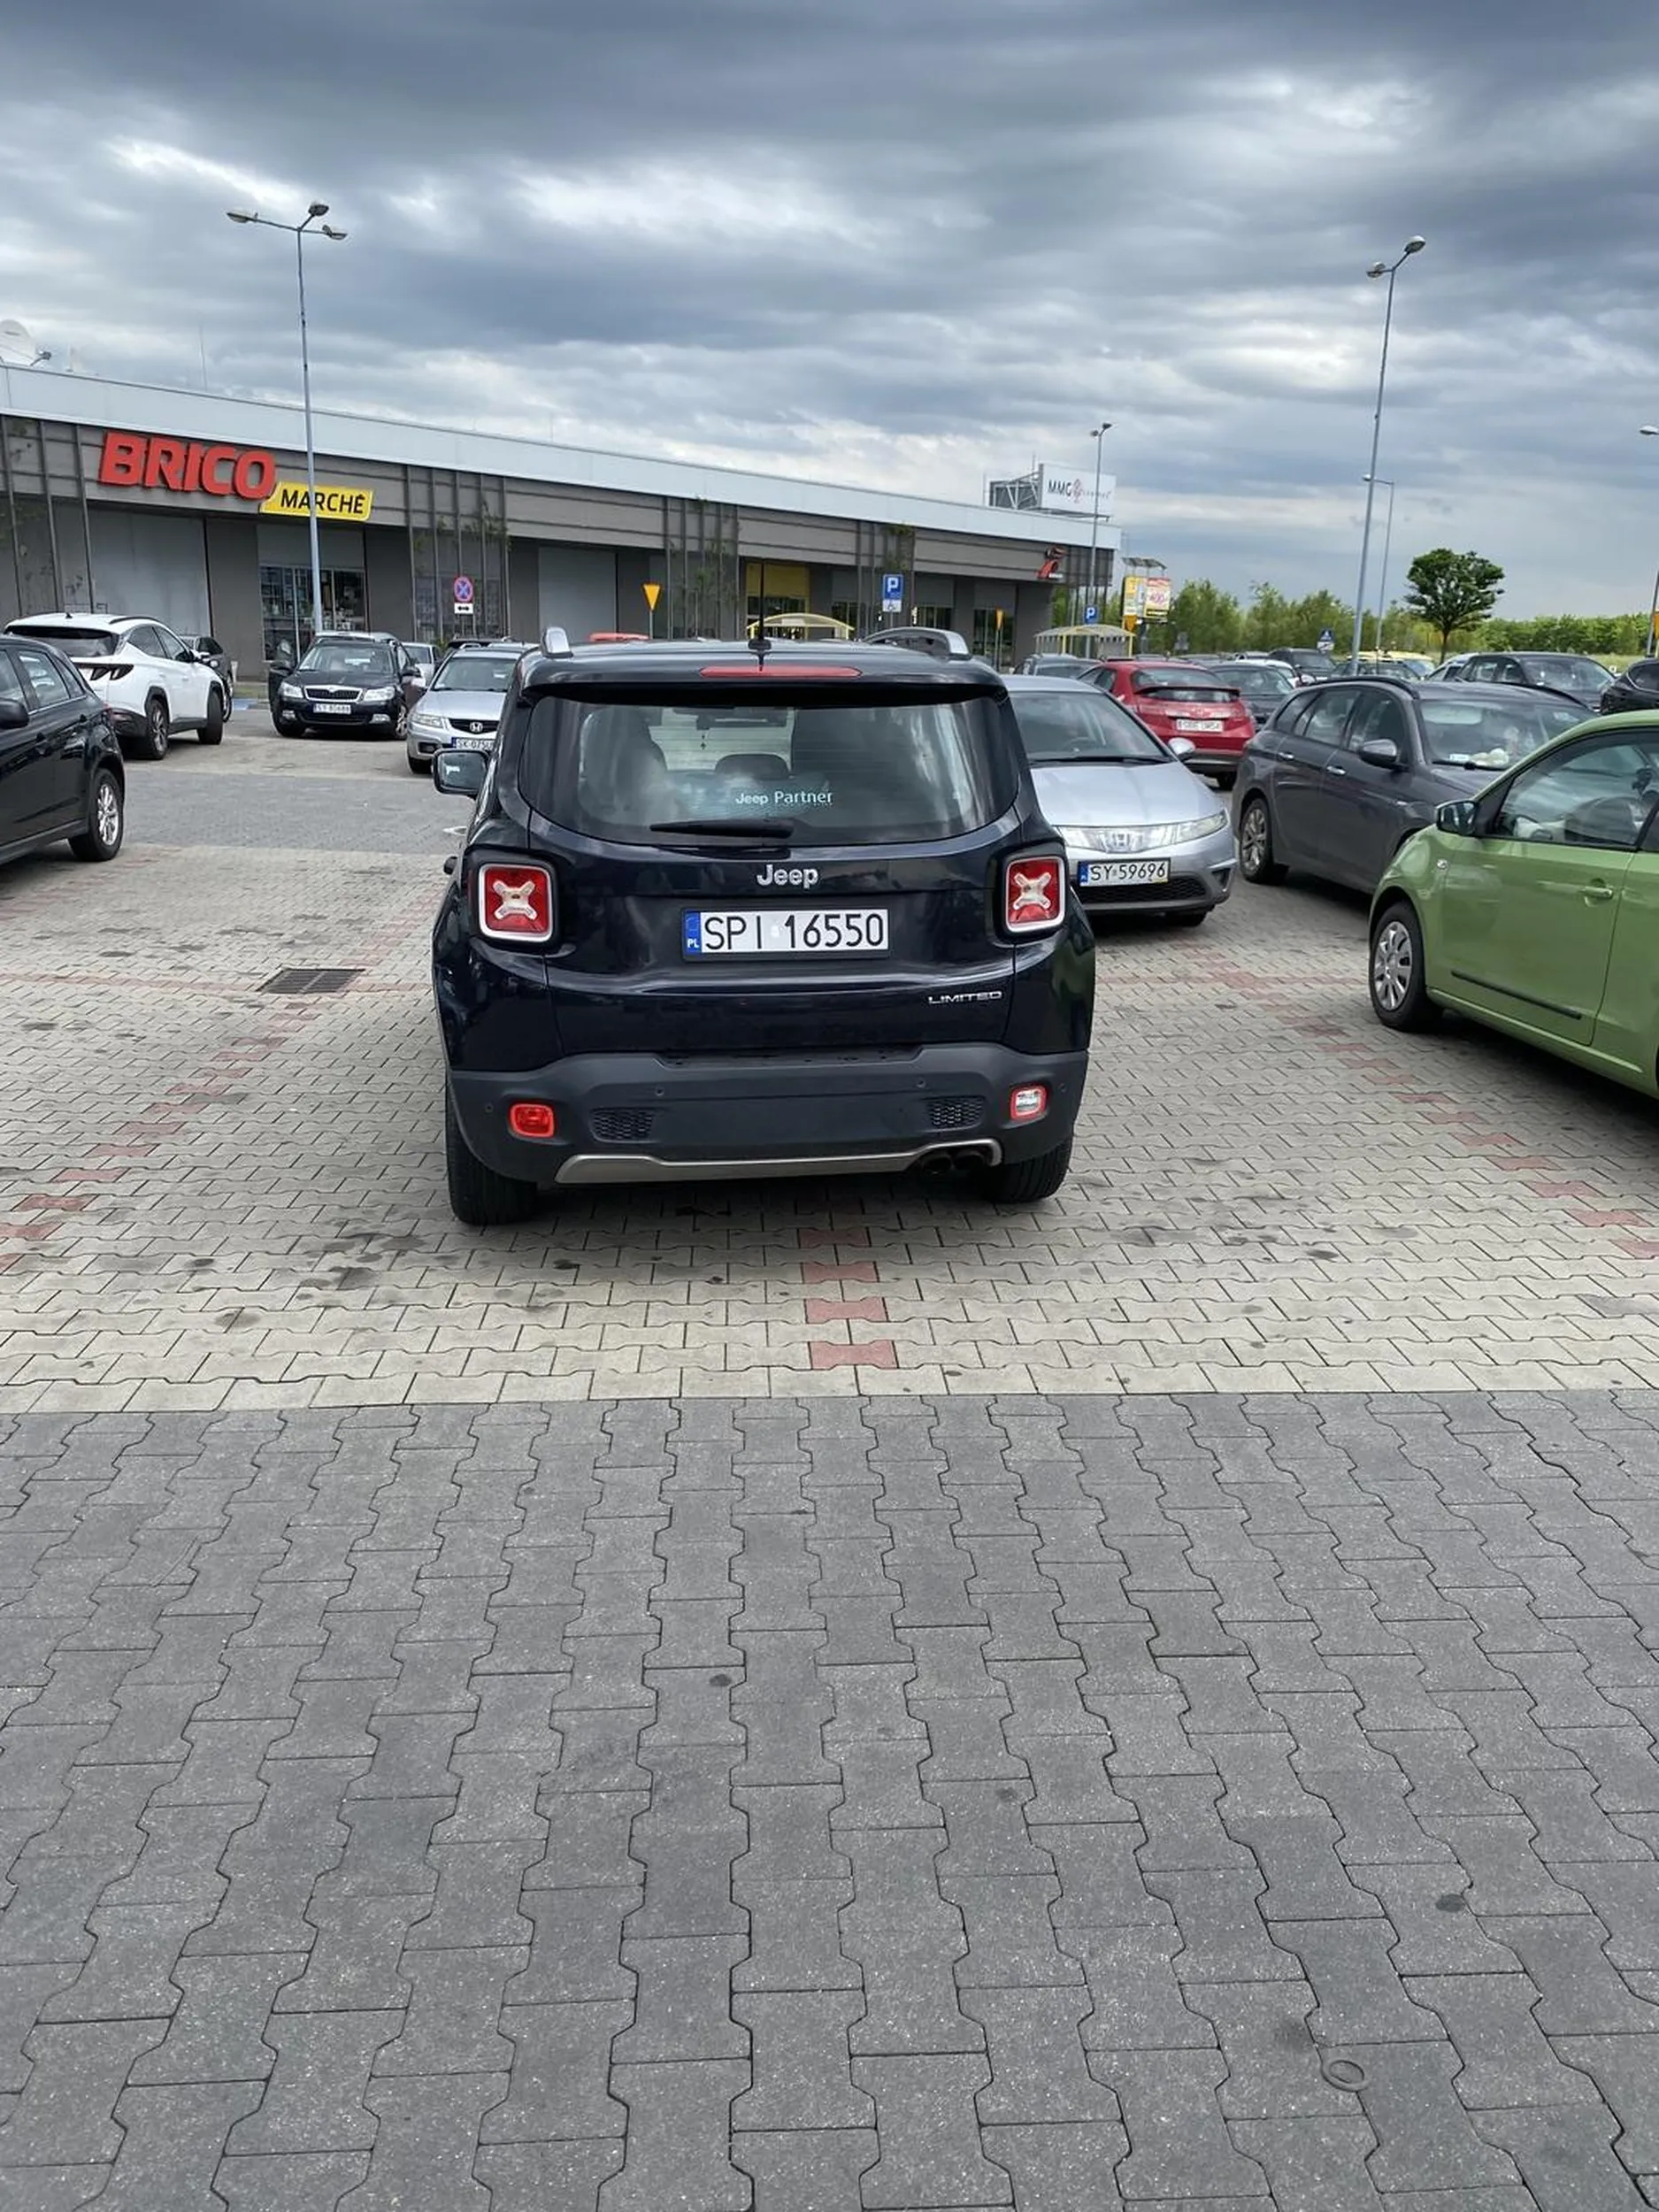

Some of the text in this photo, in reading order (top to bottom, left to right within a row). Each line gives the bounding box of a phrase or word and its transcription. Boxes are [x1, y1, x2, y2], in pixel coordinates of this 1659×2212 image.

[99, 431, 276, 500] BRICO
[280, 488, 365, 514] MARCHÉ
[887, 577, 899, 593] P
[1087, 607, 1095, 619] P
[735, 790, 833, 805] Jeep Partner
[757, 864, 818, 889] Jeep
[1090, 864, 1113, 881] SY
[1118, 862, 1166, 880] 59696
[704, 913, 884, 950] SPI 16550
[687, 938, 700, 949] PL
[928, 991, 1002, 1004] LIMITED
